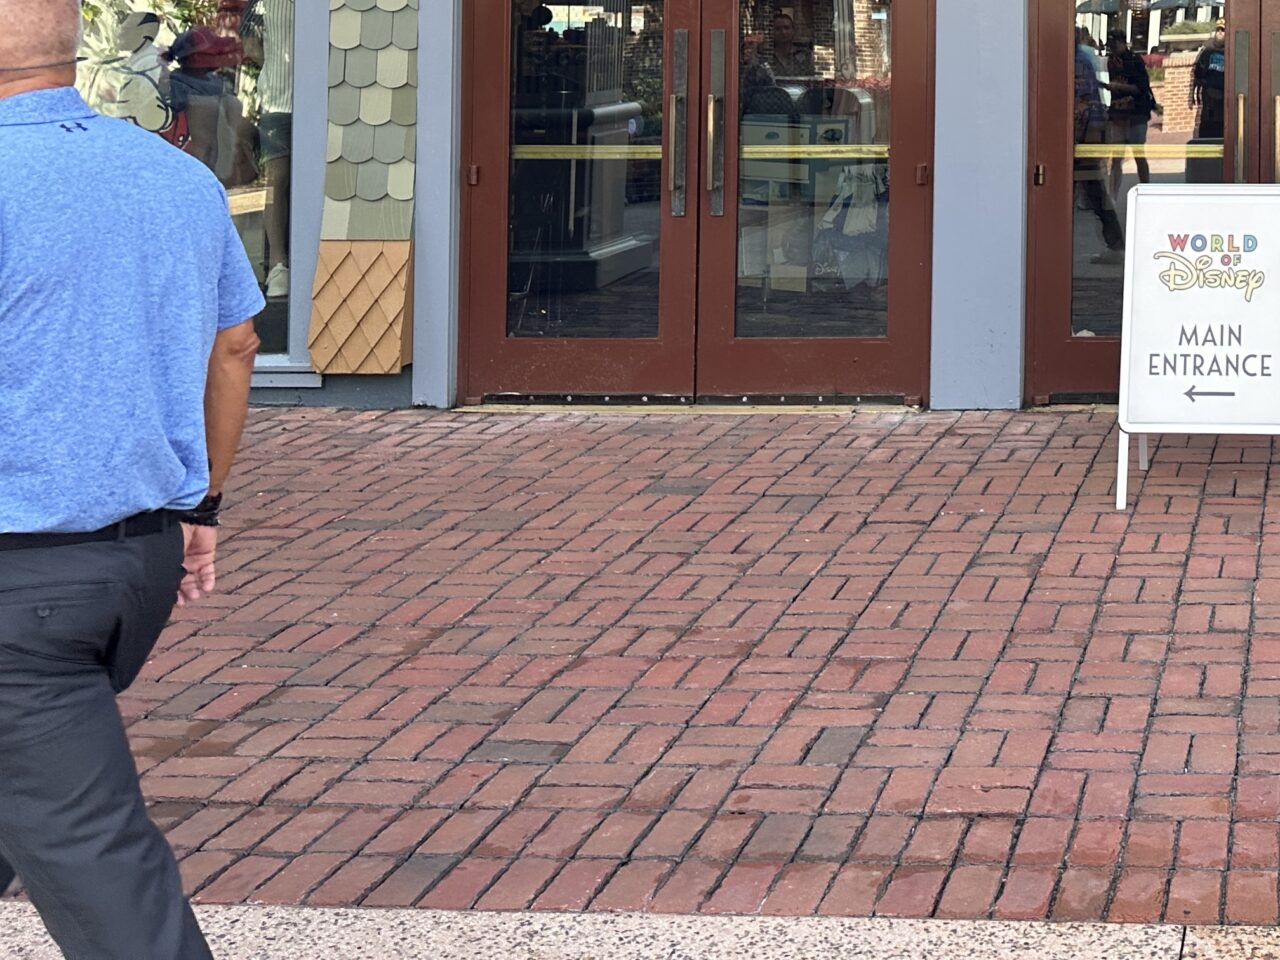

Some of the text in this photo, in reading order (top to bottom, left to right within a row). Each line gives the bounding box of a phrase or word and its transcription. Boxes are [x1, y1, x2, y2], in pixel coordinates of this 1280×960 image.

[1168, 234, 1258, 253] WORLD
[1220, 254, 1242, 267] OF
[1153, 251, 1265, 302] Disney
[1178, 324, 1243, 347] MAIN
[1149, 353, 1273, 377] ENTRANCE
